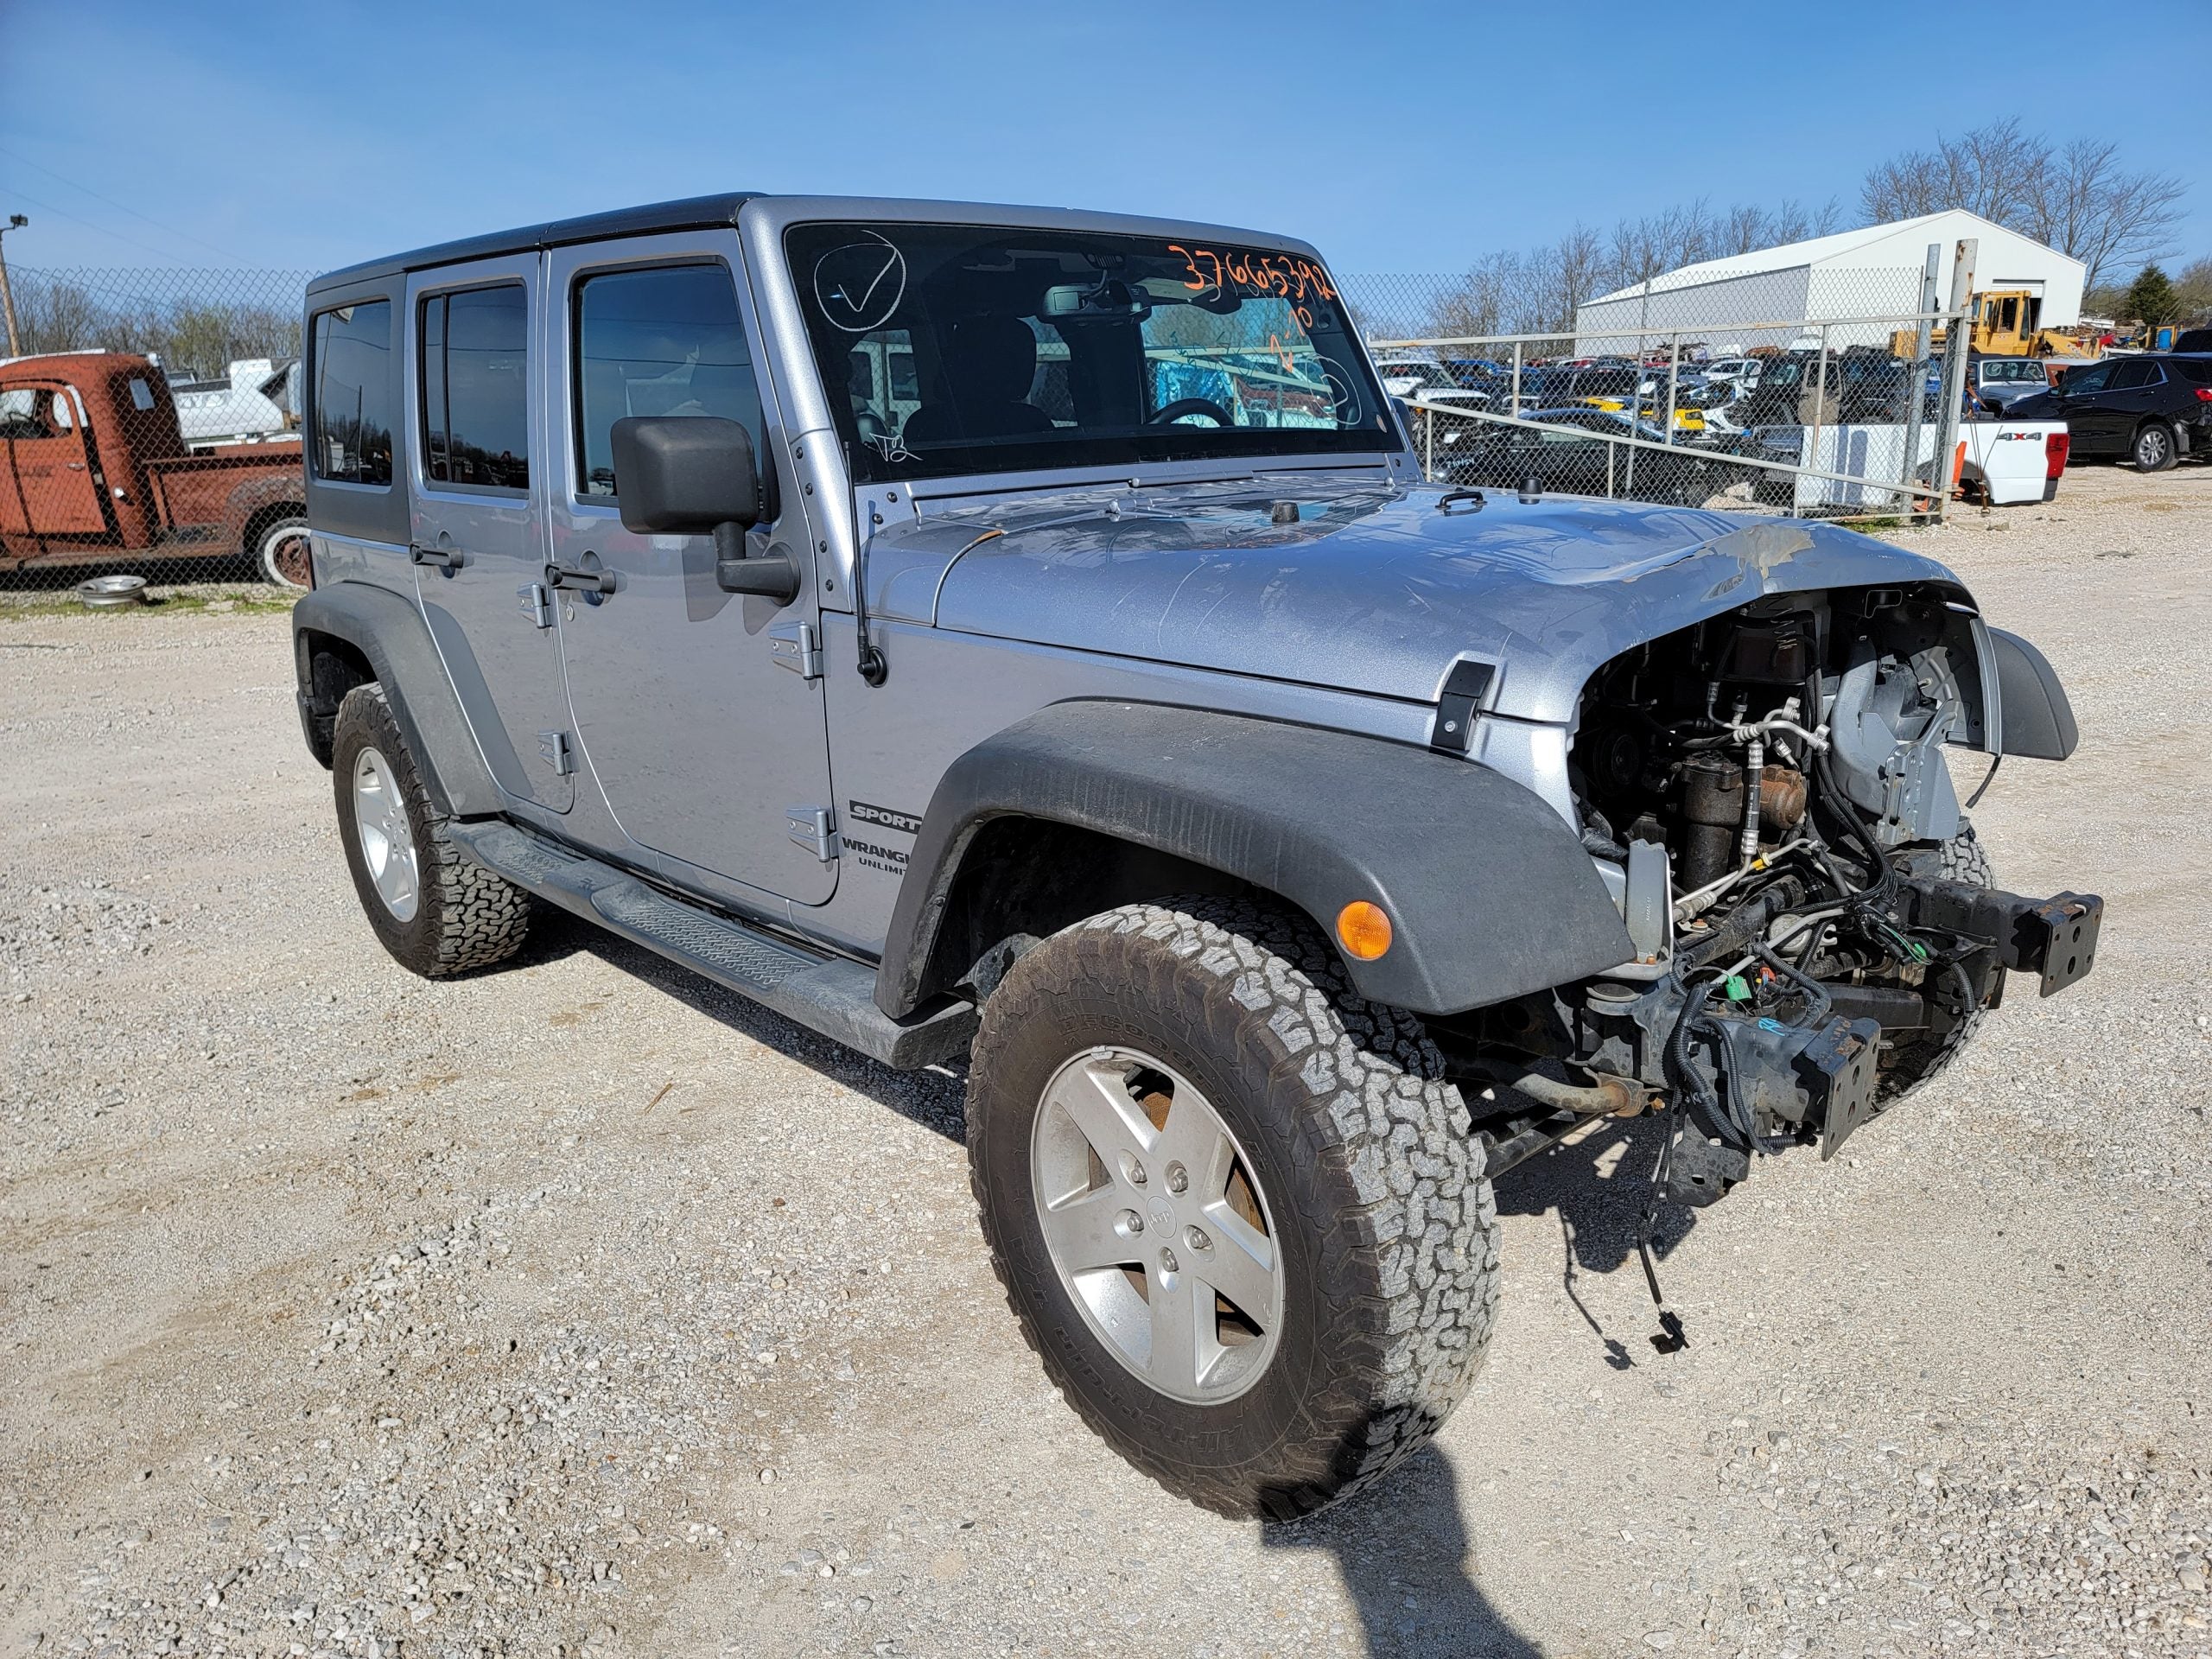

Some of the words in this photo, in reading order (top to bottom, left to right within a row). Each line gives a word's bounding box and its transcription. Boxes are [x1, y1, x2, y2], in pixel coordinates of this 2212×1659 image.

[1168, 245, 1337, 301] 37665392
[850, 804, 923, 830] SPORT
[858, 856, 906, 875] UNLIMI
[1150, 1211, 1170, 1224] Jeep
